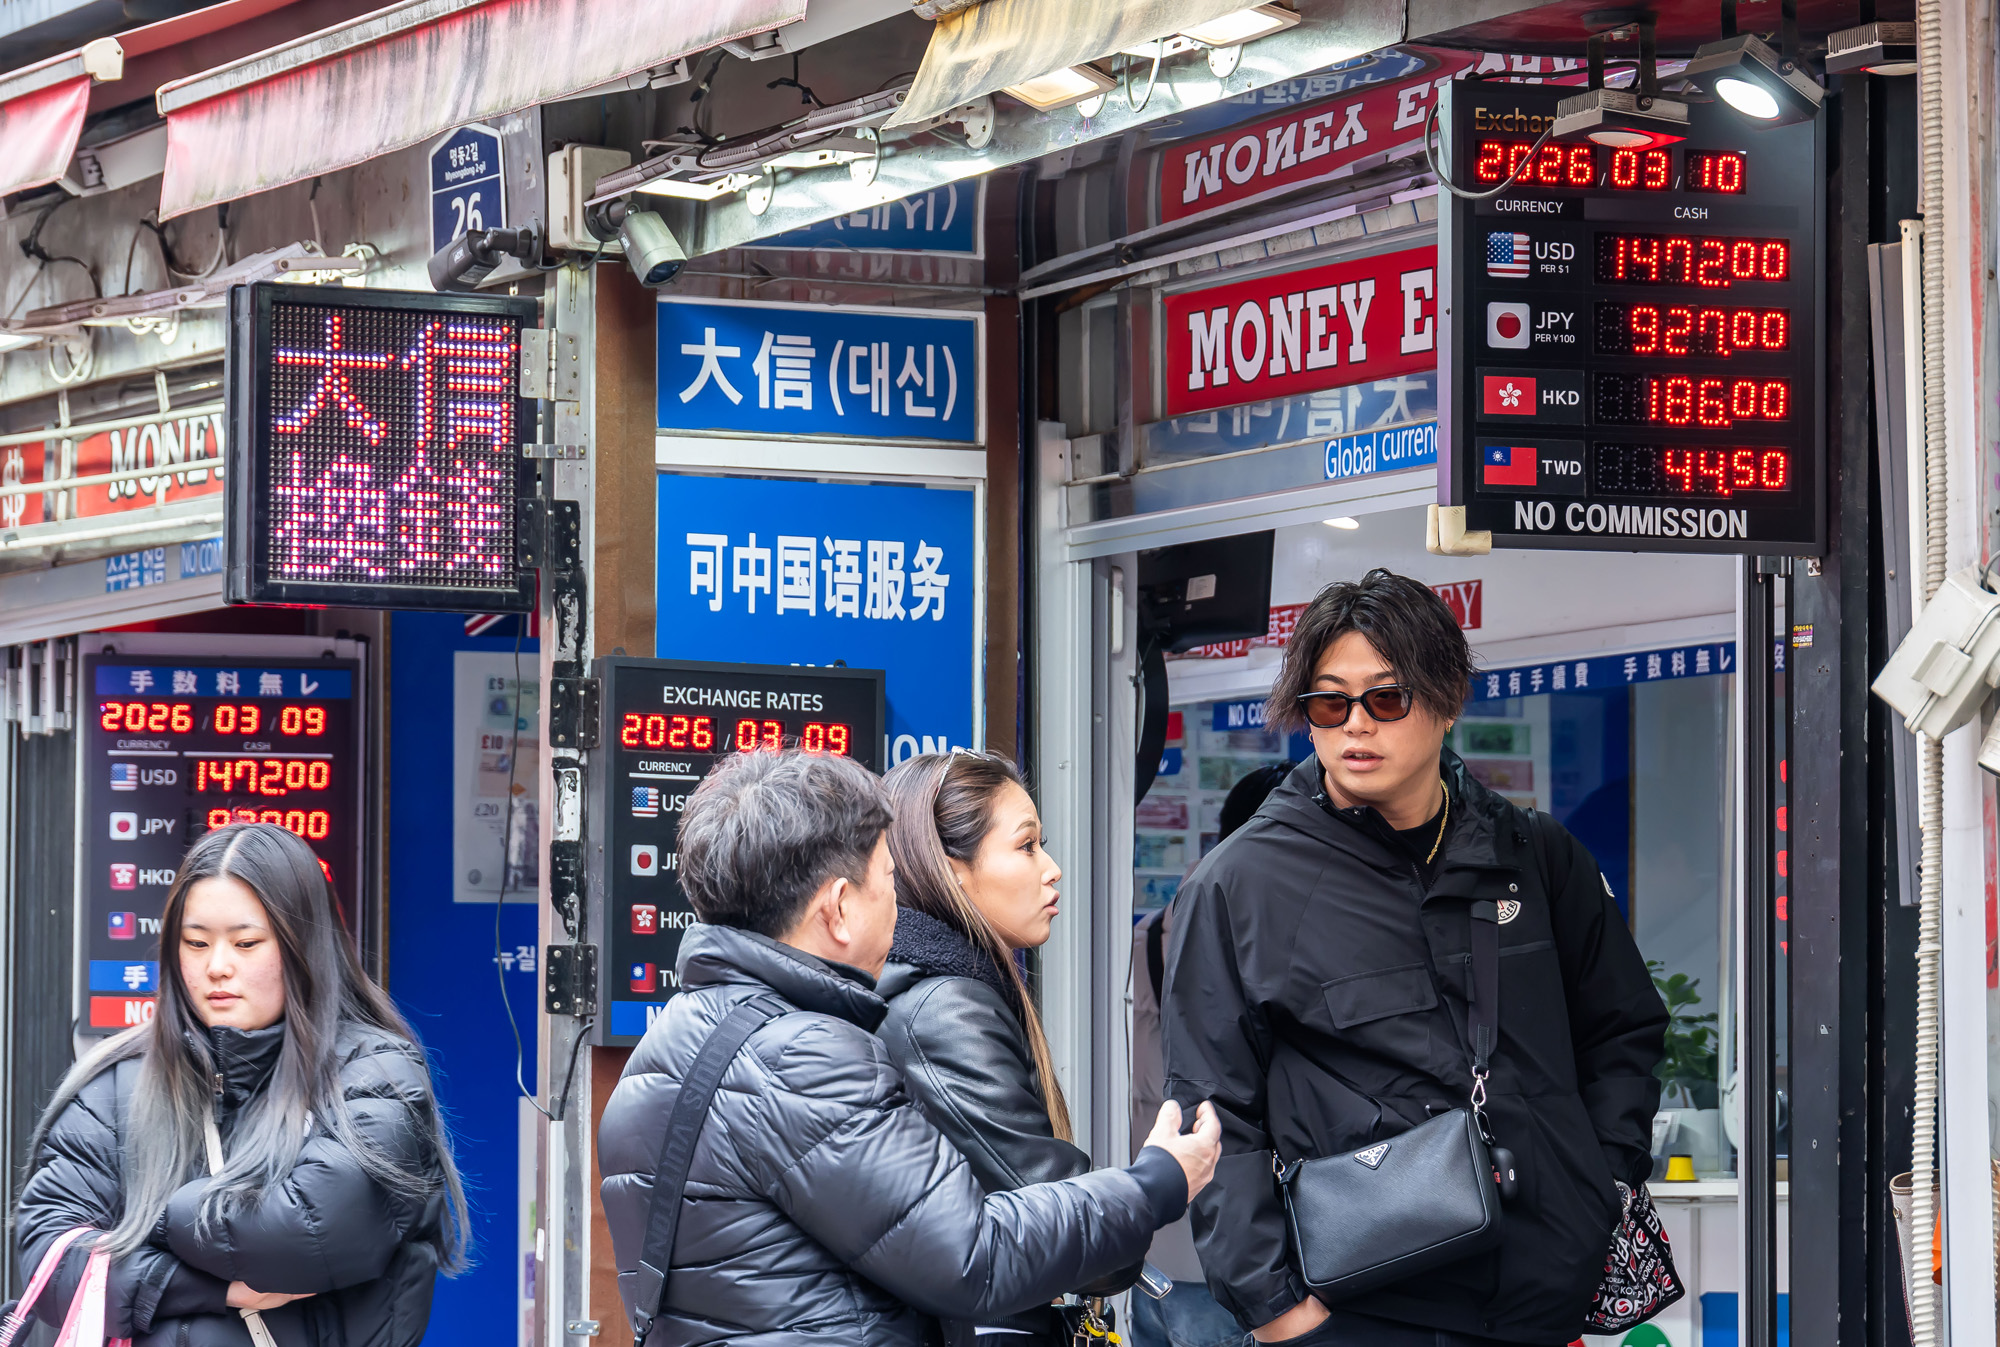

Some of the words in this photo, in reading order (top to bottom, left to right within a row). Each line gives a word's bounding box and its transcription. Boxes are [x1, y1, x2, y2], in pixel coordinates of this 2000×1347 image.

[449, 142, 479, 168] 명동2길
[1479, 143, 1591, 184] 2026
[1613, 150, 1667, 187] 03
[1703, 155, 1741, 191] 10
[451, 192, 483, 241] 26
[1495, 199, 1563, 214] CURRENCY
[1674, 206, 1708, 220] CASH
[1535, 242, 1575, 260] USD
[1540, 264, 1556, 273] PER
[1535, 311, 1575, 330] JPY
[1188, 277, 1376, 392] MONEY
[1535, 333, 1552, 343] PER
[277, 315, 519, 452] 大信
[1542, 390, 1580, 406] HKD
[1325, 432, 1377, 479] Global
[1381, 425, 1438, 462] curren
[1542, 460, 1582, 476] TWD
[1515, 501, 1556, 532] NO
[1565, 502, 1748, 539] COMMISSION
[686, 532, 950, 622] 可中国语服务
[663, 686, 761, 708] EXCHANGE
[766, 691, 824, 712] RATES
[101, 702, 193, 732] 2026
[214, 704, 260, 735] 03
[281, 706, 326, 736] 09
[621, 713, 712, 749] 2026
[803, 723, 849, 756] 09
[117, 740, 170, 750] CURRENCY
[243, 742, 271, 751] CASH
[638, 760, 692, 773] CURRENCY
[140, 769, 177, 786] USD
[140, 818, 176, 836] JPY
[139, 869, 176, 886] HKD
[138, 918, 162, 934] TW
[660, 911, 697, 929] HKD
[492, 945, 537, 973] 뉴질
